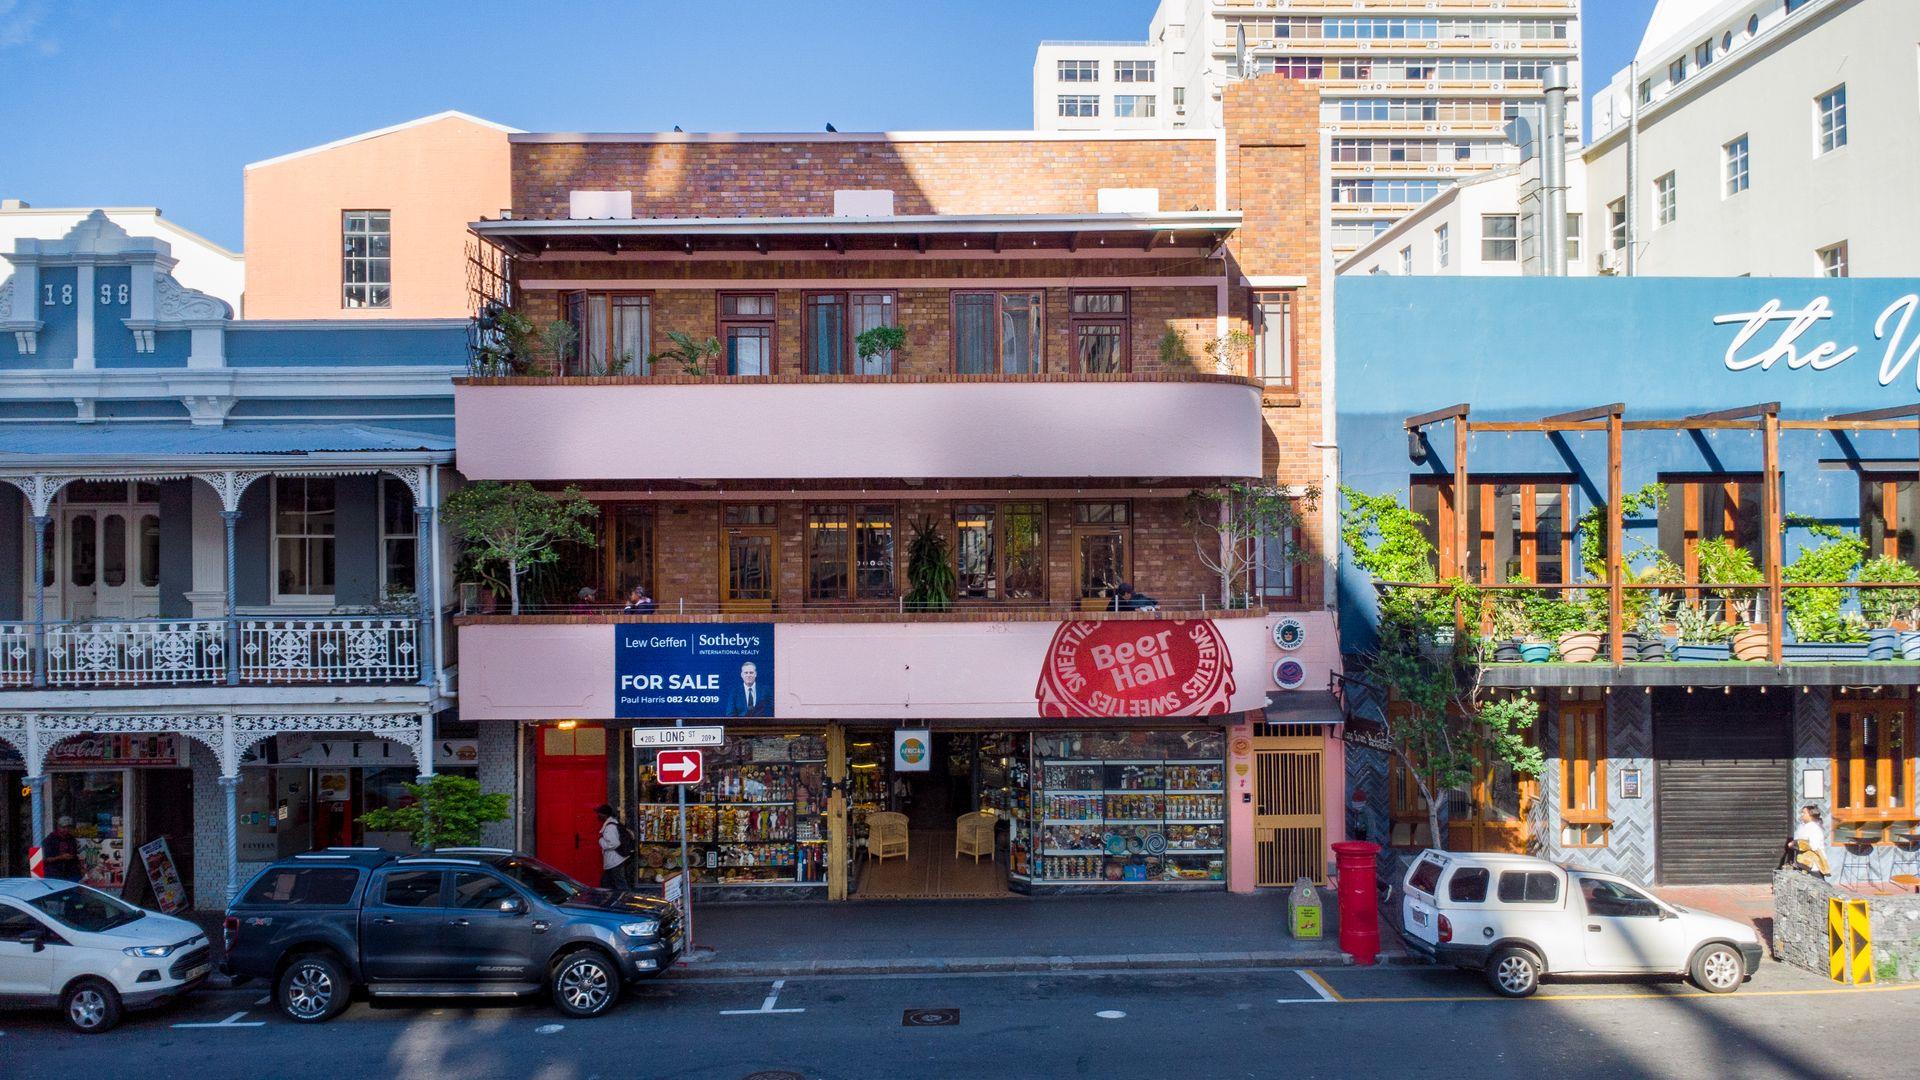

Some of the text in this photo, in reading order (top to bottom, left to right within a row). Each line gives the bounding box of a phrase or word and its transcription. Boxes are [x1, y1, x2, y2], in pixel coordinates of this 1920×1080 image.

[44, 284, 72, 305] 18
[1713, 296, 1858, 371] the
[625, 636, 687, 648] Lew Geffen
[699, 634, 760, 648] Sotheby's
[1090, 630, 1172, 670] Beer
[1057, 620, 1102, 693] SWEETIES
[1182, 624, 1216, 699] SWEETIES
[621, 674, 720, 690] FOR SALE
[1110, 652, 1175, 692] Hall
[660, 731, 685, 743] LONG
[701, 734, 712, 742] 209
[52, 738, 104, 758] Coca-Cola
[901, 746, 925, 755] AFRICAN
